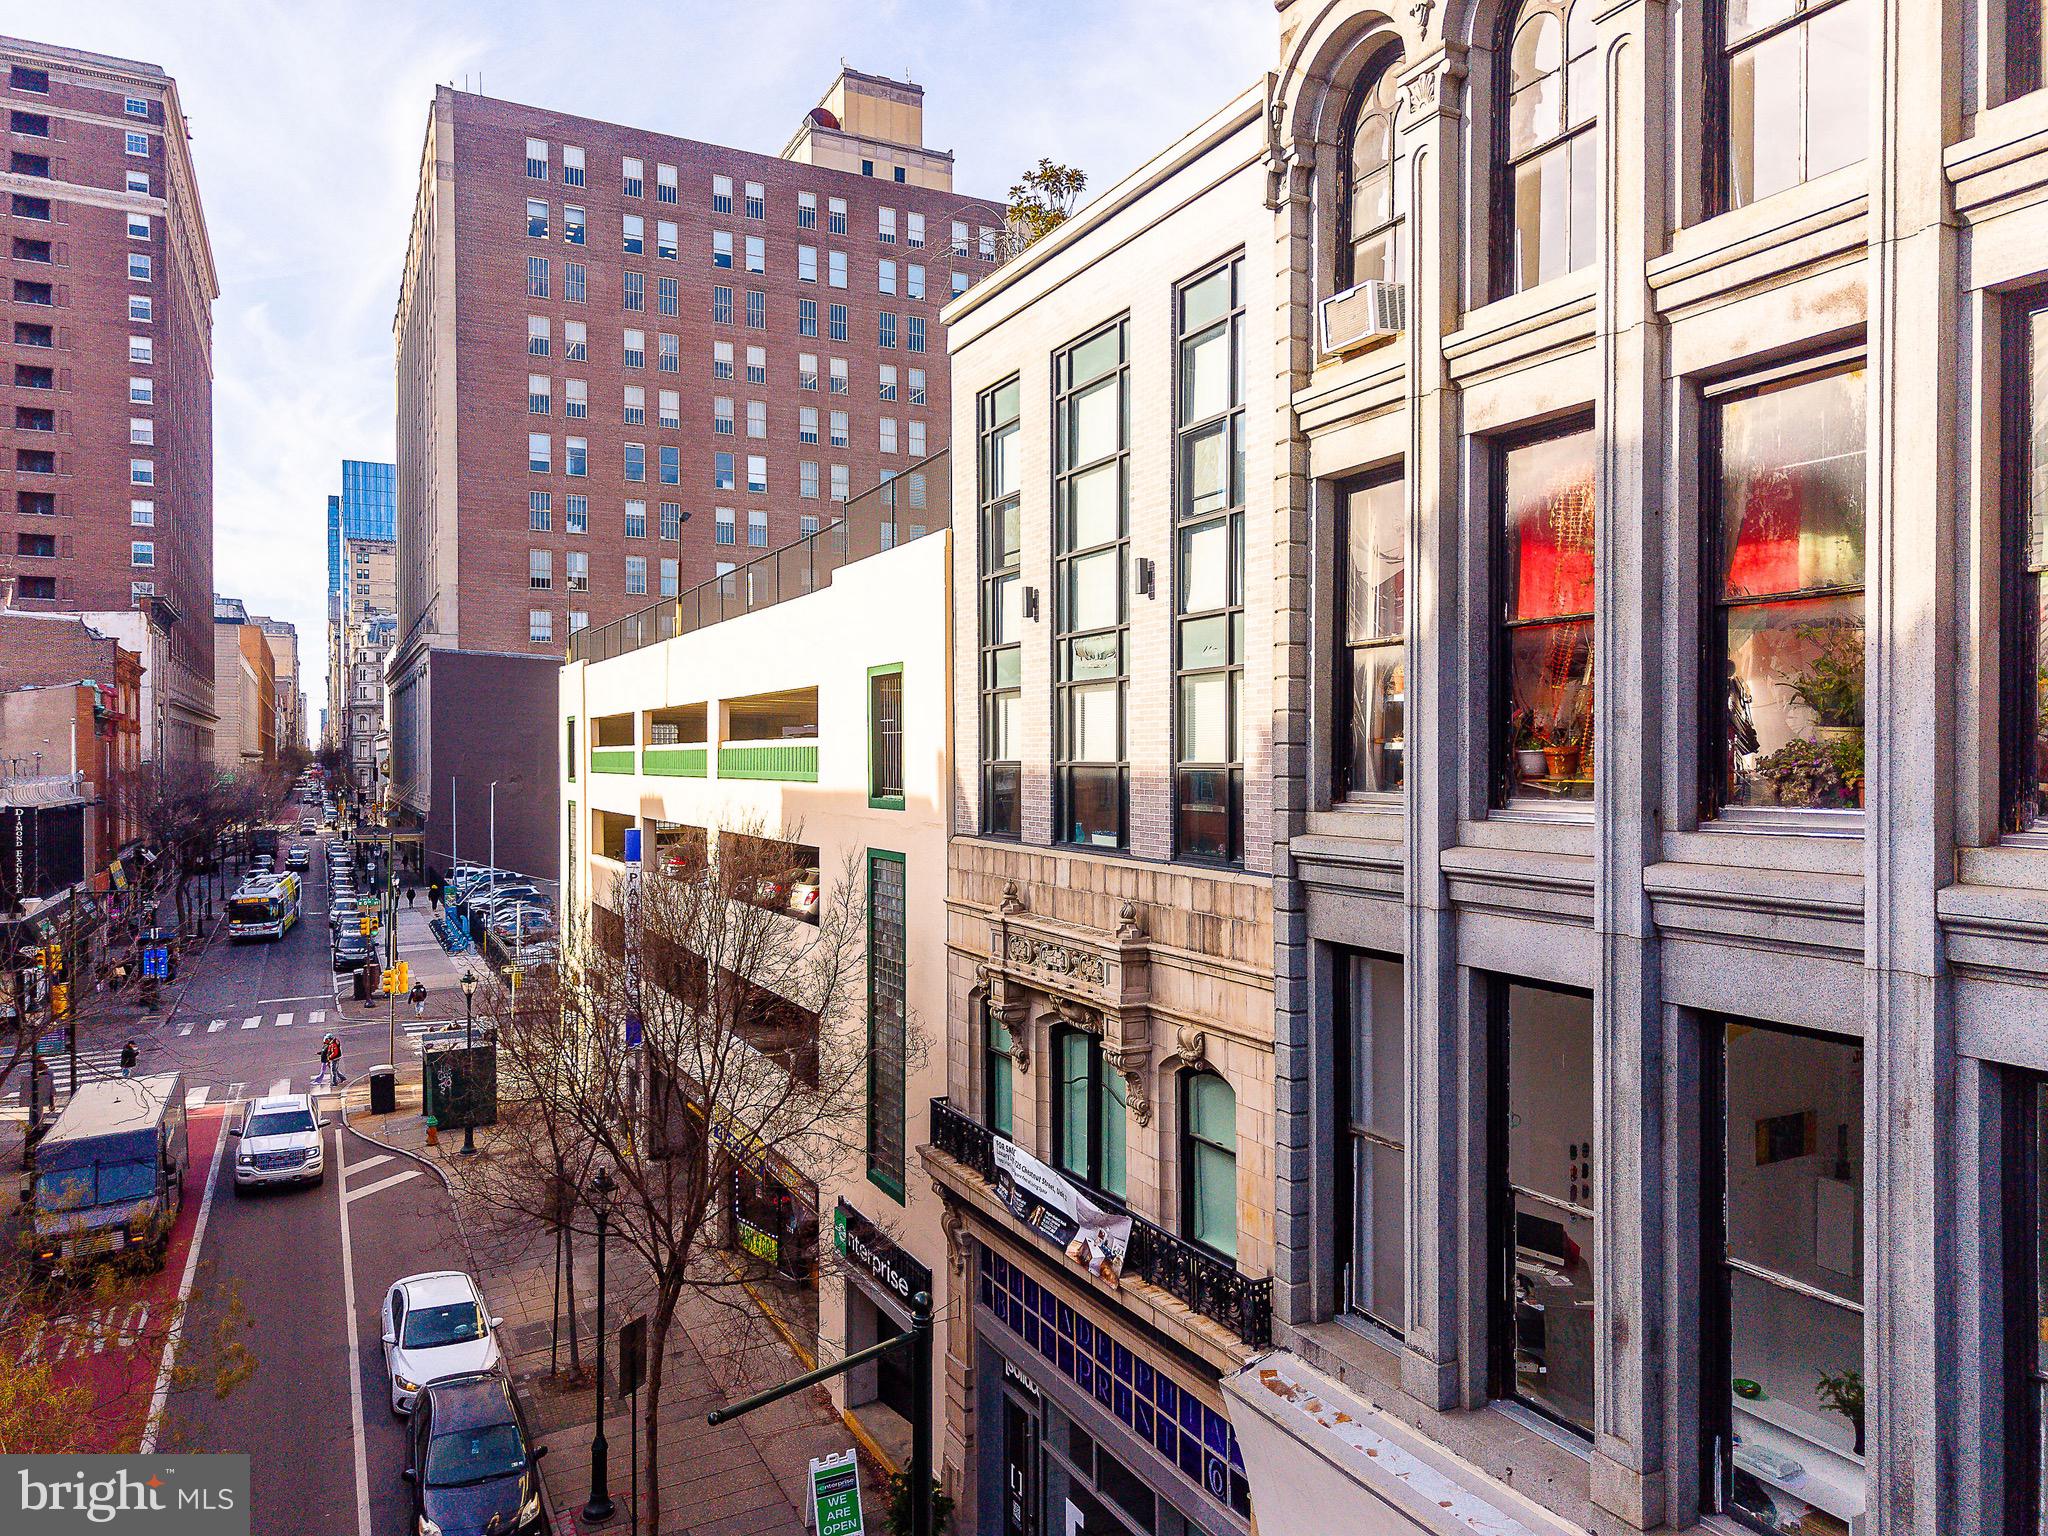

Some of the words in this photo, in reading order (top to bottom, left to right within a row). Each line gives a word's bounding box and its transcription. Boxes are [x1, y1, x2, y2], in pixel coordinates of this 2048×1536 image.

[15, 808, 24, 847] DIAMOND
[15, 849, 24, 894] EXCHANGE
[1021, 1165, 1042, 1183] Chestnut
[835, 1222, 909, 1297] enterprise
[828, 1494, 848, 1507] WE
[826, 1506, 851, 1521] ARE
[823, 1518, 857, 1536] OPEN
